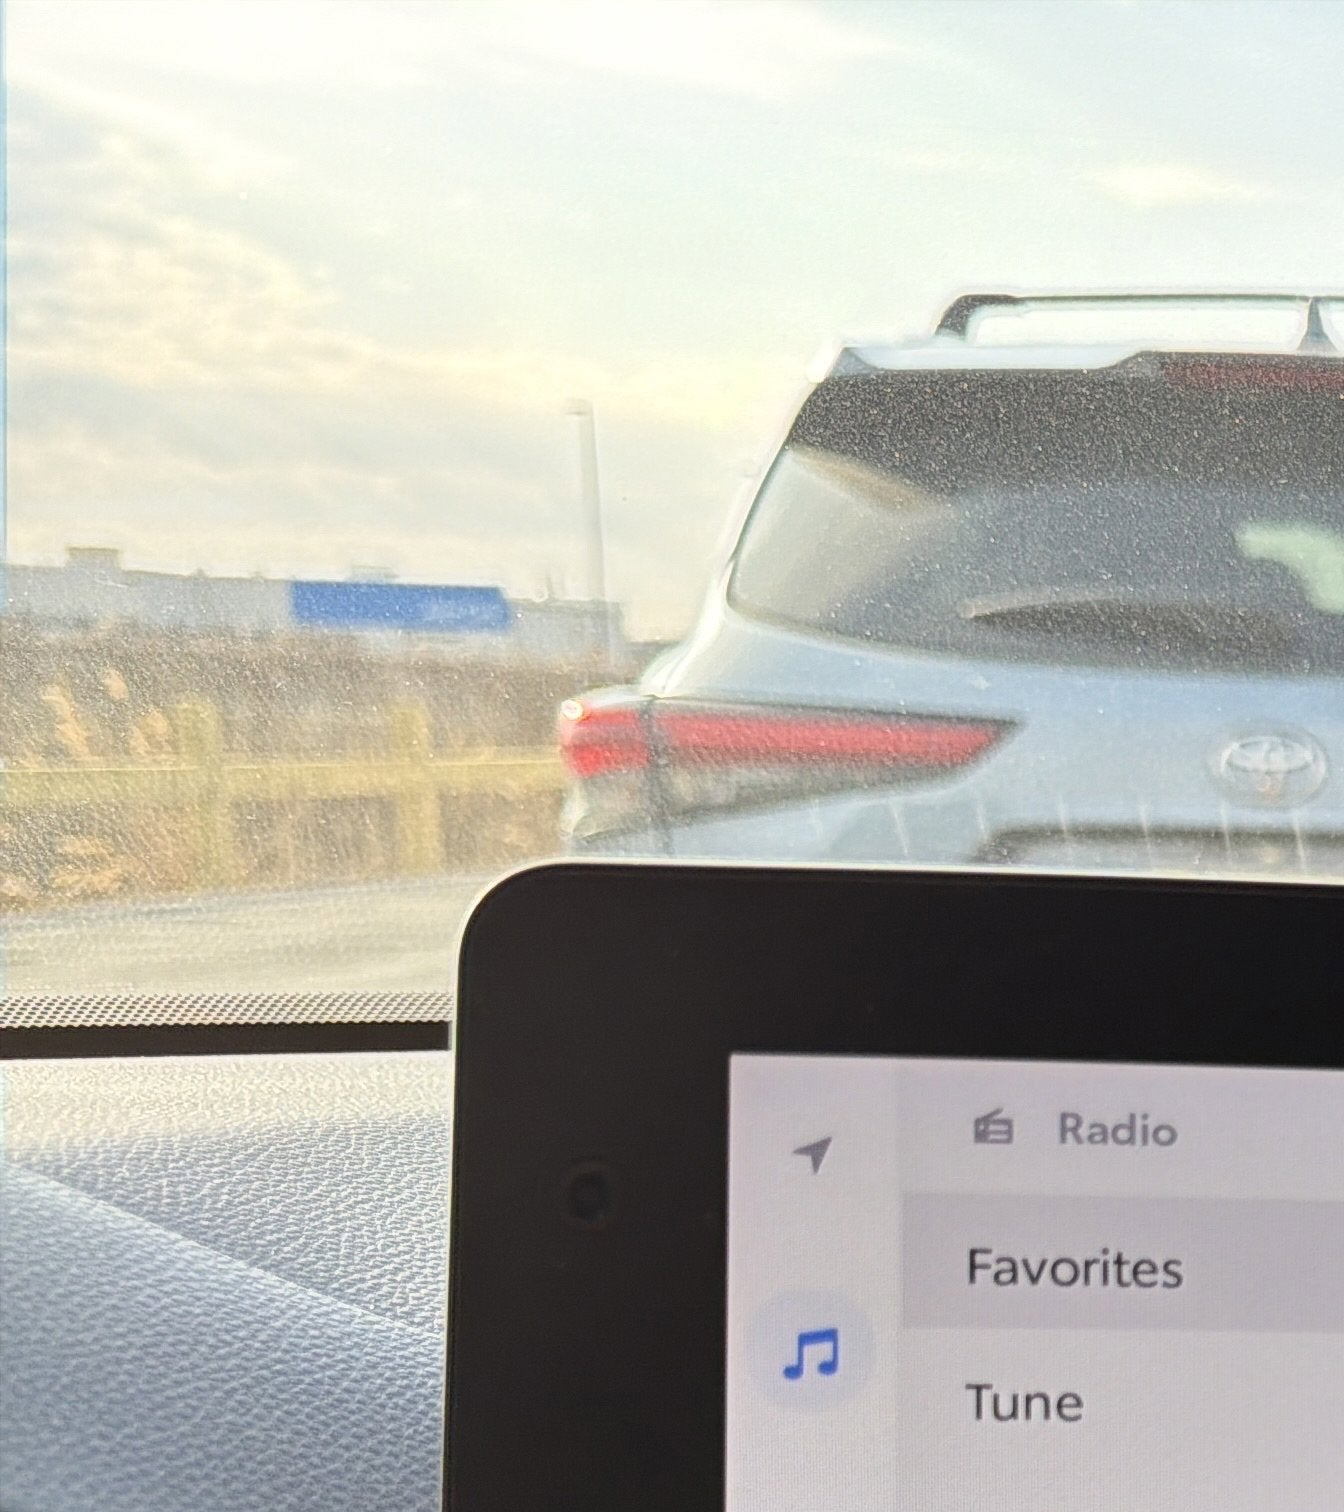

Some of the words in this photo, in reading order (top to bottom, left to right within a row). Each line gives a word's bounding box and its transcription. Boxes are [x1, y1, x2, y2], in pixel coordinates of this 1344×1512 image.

[1058, 1110, 1178, 1149] Radio
[966, 1246, 1184, 1290] Favorites
[966, 1382, 1084, 1423] Tune
